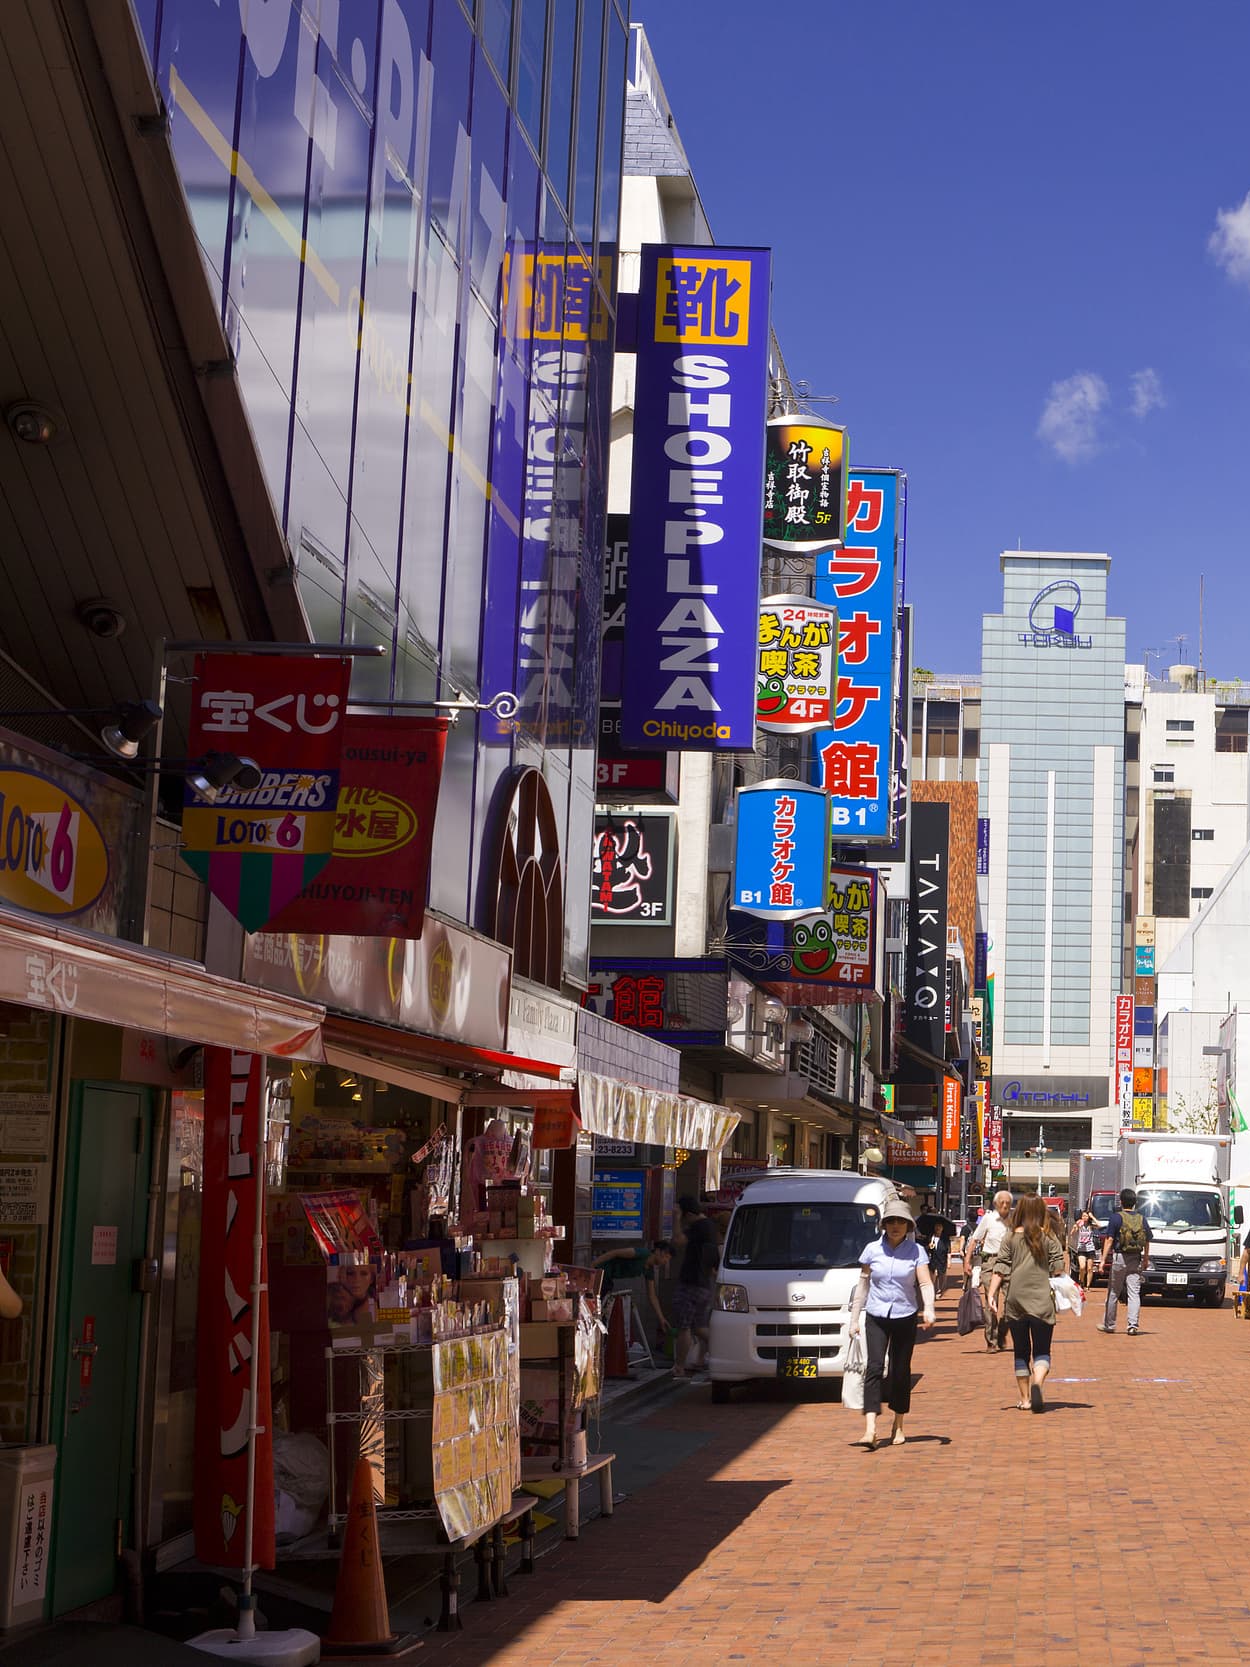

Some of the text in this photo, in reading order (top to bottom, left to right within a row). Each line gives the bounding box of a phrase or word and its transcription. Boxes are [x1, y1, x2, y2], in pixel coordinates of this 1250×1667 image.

[662, 266, 742, 337] 靴
[765, 471, 777, 509] 吉祥寺店
[785, 441, 813, 525] 竹取御殿
[815, 512, 832, 524] 5F
[758, 614, 830, 648] まんが
[821, 480, 884, 800] カラオケ館
[1017, 633, 1093, 649] TOKYU
[761, 650, 820, 678] 喫茶
[201, 690, 340, 735] 宝くじ
[789, 700, 824, 718] 4F
[643, 719, 731, 741] Chiyoda
[340, 747, 427, 766] ousui-ya
[831, 807, 867, 826] B1
[216, 813, 301, 848] LOTO 6
[52, 801, 74, 893] 6
[769, 795, 797, 907] カラオケ館
[641, 902, 663, 916] 3F
[740, 890, 763, 904] B1
[834, 914, 867, 937] 喫茶
[26, 954, 79, 1009] 宝くじ
[839, 964, 864, 982] 4F
[1119, 998, 1131, 1047] カラオケ
[1020, 1092, 1089, 1101] TOKYU
[946, 1104, 954, 1139] Kitchen
[892, 1149, 928, 1157] Kitchen
[785, 1365, 817, 1376] 26-62
